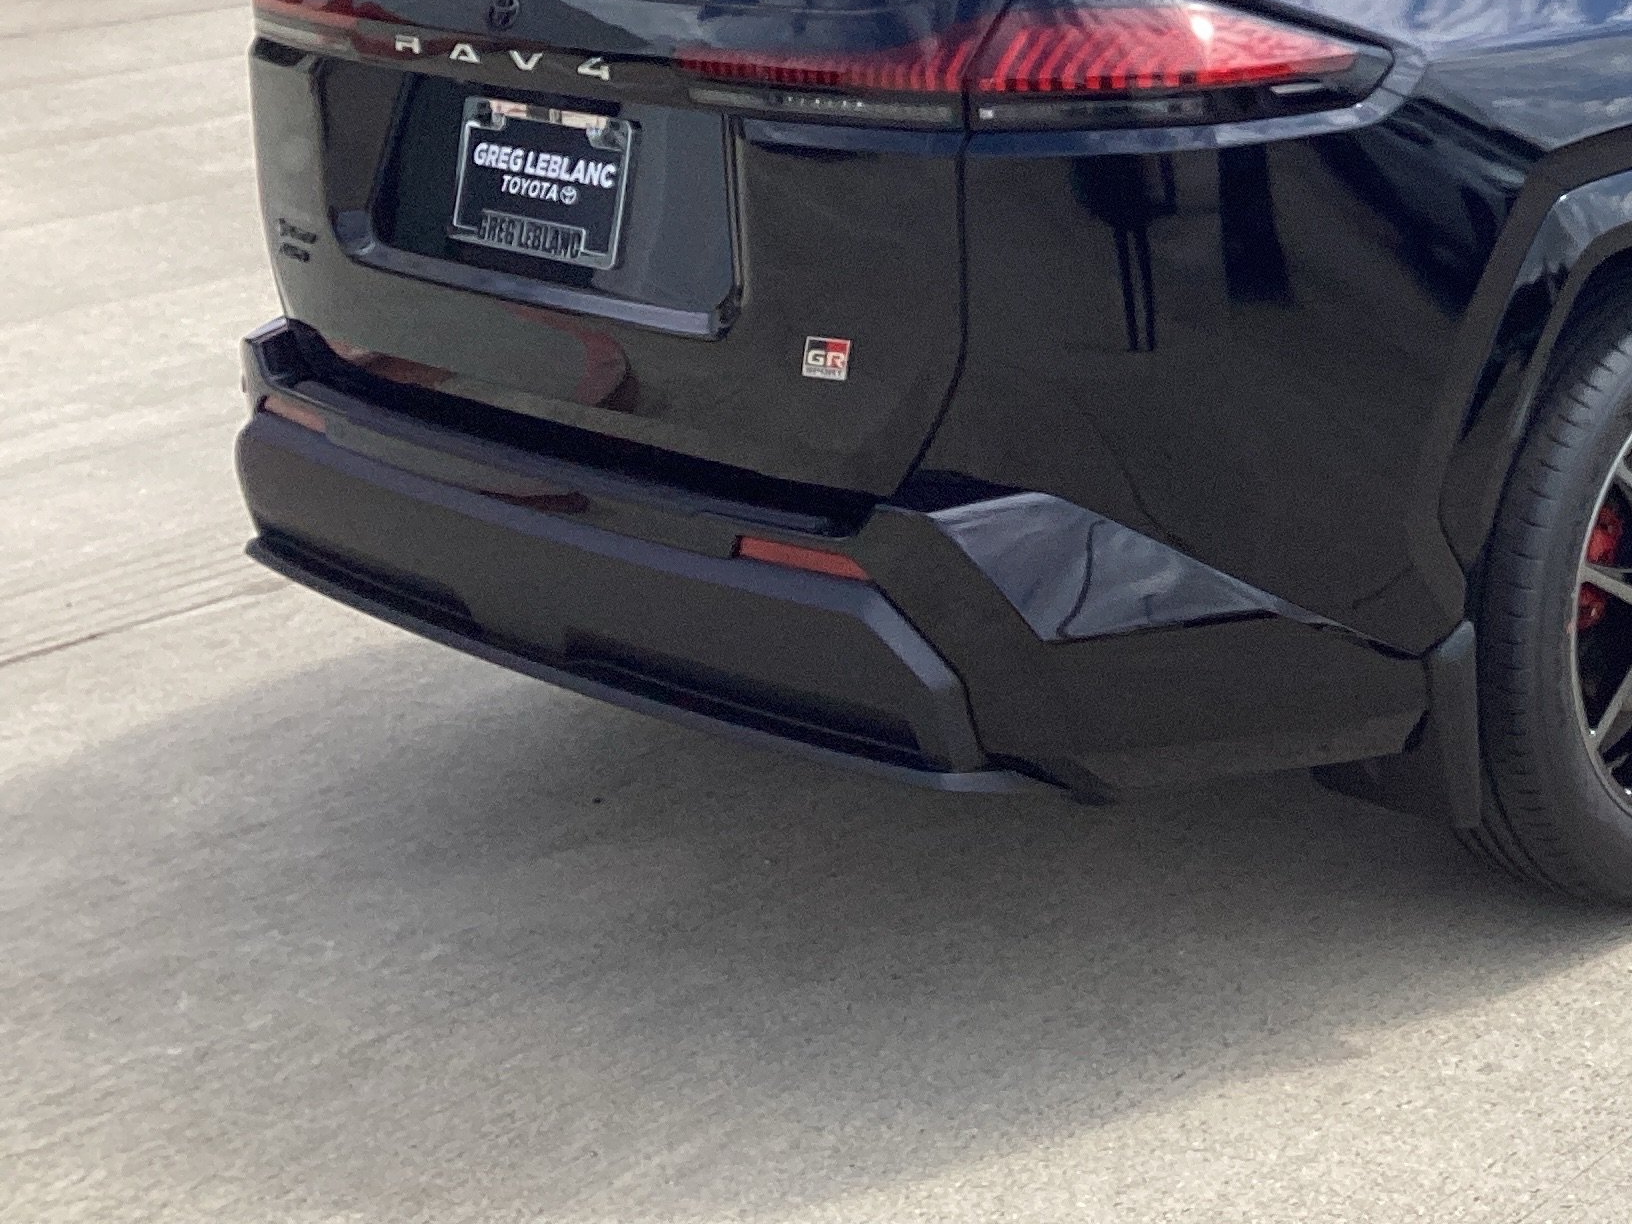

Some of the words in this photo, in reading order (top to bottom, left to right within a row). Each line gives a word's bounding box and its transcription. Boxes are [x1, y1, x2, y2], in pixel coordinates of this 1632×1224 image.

[395, 34, 610, 81] RAV4
[473, 142, 525, 173] GREG
[523, 151, 617, 189] LEBLANC
[501, 175, 560, 202] TOYOTA
[480, 213, 516, 247] GREG
[520, 221, 582, 259] LEBLANC
[807, 349, 845, 368] GR
